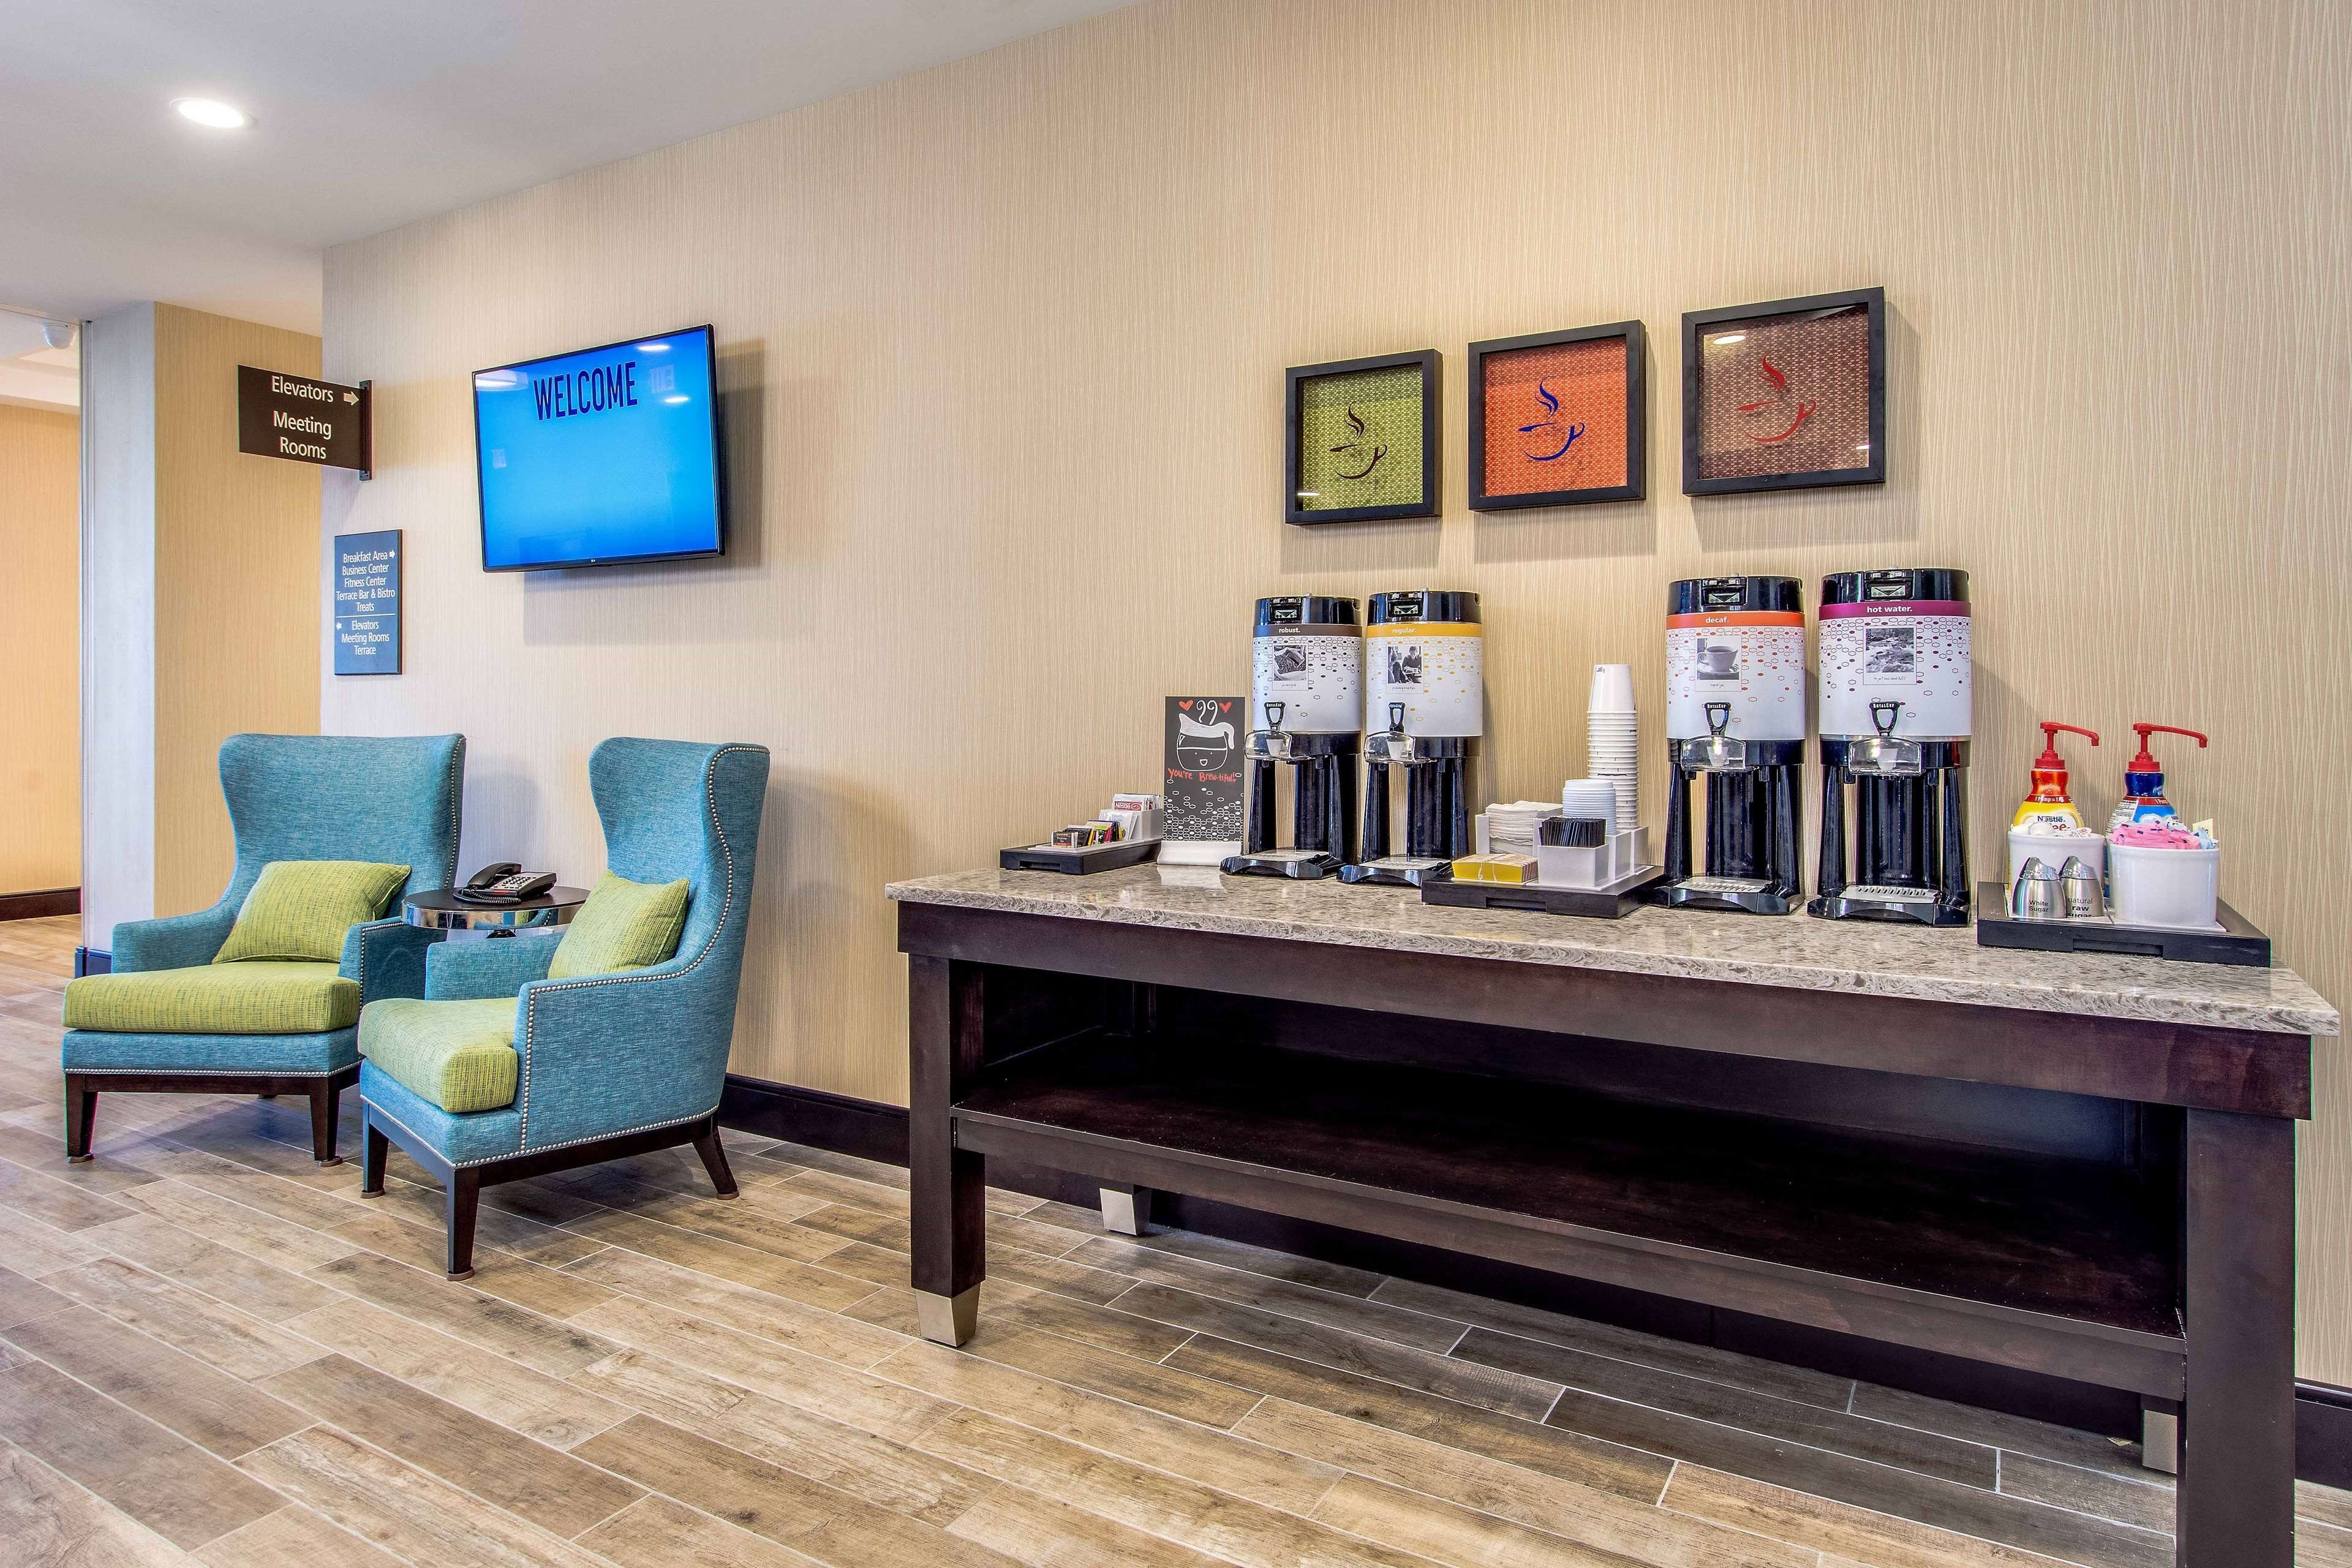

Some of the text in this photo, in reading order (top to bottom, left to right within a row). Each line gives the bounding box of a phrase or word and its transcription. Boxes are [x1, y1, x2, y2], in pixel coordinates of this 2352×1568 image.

[271, 375, 334, 402] Elevators
[533, 361, 638, 421] WELCOME
[273, 410, 332, 440] Meeting
[279, 436, 327, 459] Rooms
[343, 551, 388, 564] Breakfast Area
[342, 564, 389, 576] Business Center
[344, 576, 386, 588] Fitness Center
[336, 588, 395, 601] Terrace Bar & Bistro
[356, 602, 375, 612] Treats
[352, 620, 379, 630] Elevators
[342, 632, 390, 645] Meeting Rooms
[354, 645, 376, 655] Terrace
